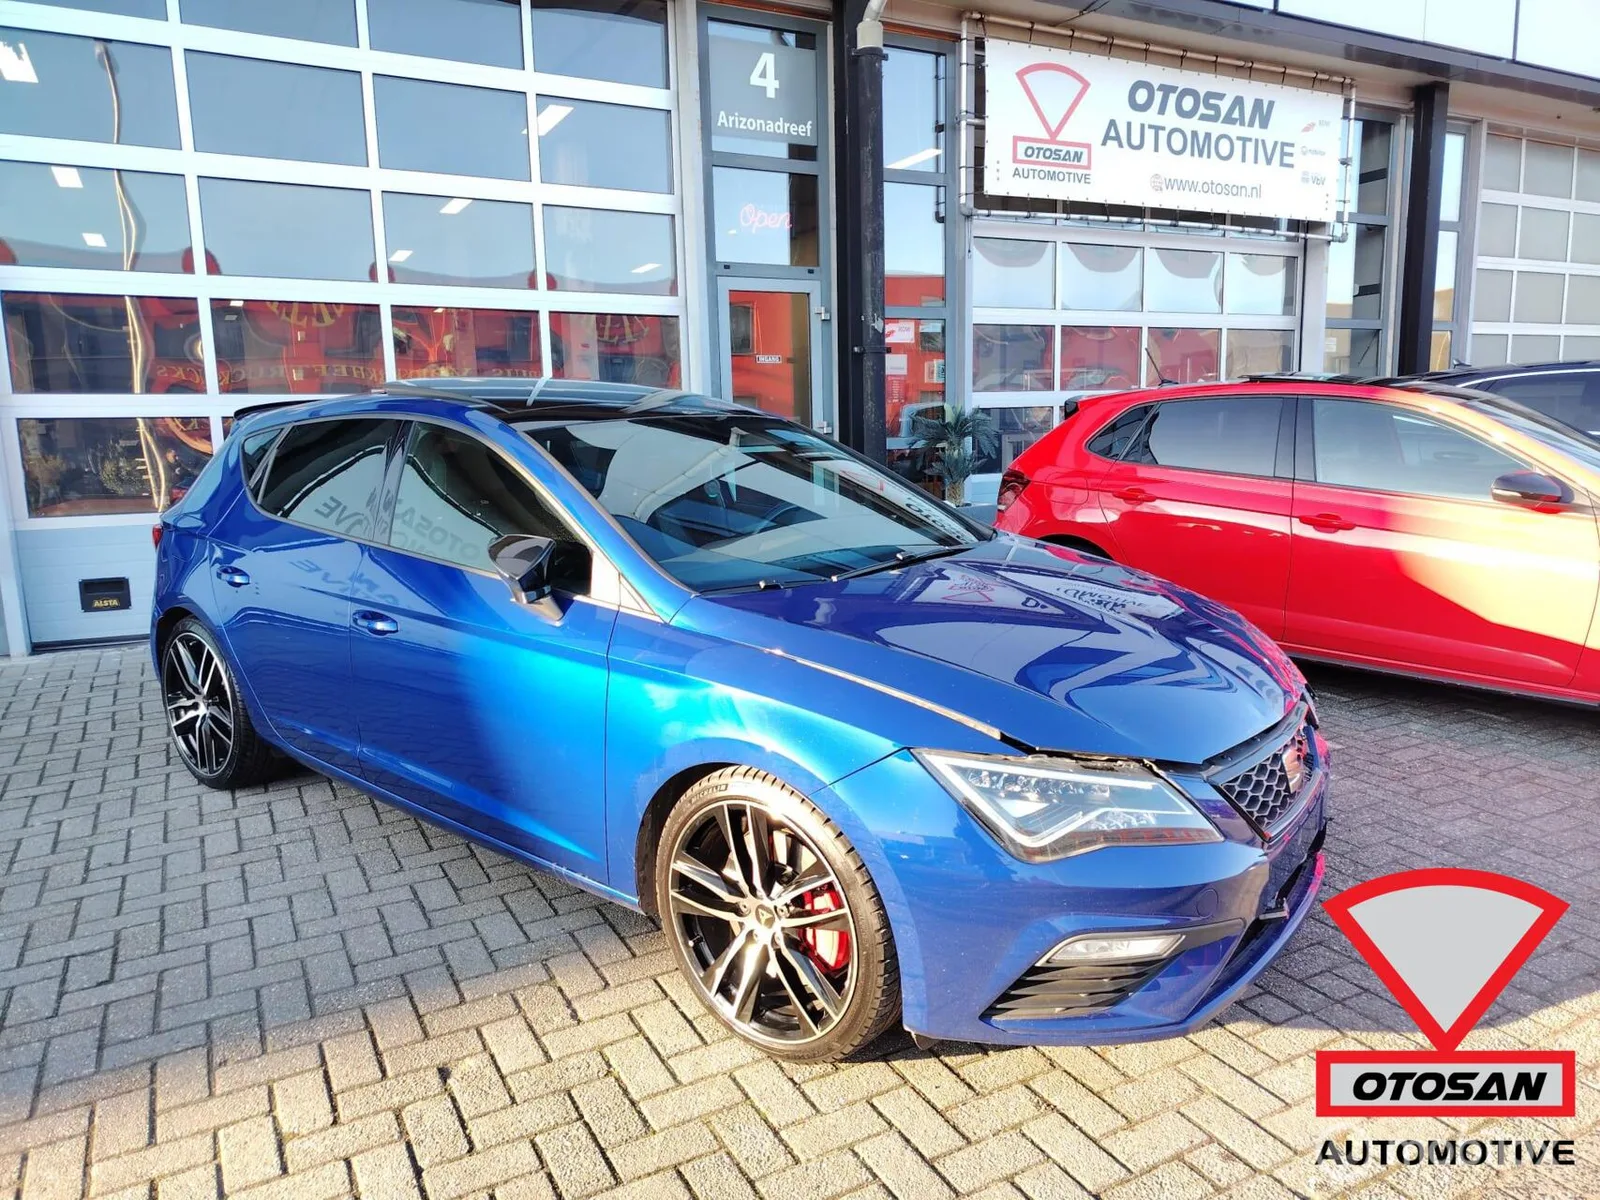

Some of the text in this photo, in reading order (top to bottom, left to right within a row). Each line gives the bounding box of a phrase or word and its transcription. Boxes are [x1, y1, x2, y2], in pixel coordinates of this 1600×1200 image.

[750, 52, 779, 98] 4
[1128, 79, 1275, 130] OTOSAN
[717, 111, 812, 138] Arizonadreef
[1024, 146, 1083, 163] OTOSAN
[1101, 119, 1295, 169] AUTOMOTIVE
[1012, 167, 1091, 184] AUTOMOTIVE
[1164, 177, 1262, 199] www.otosan.nl
[740, 203, 793, 234] Open
[93, 598, 119, 608] ALSTA
